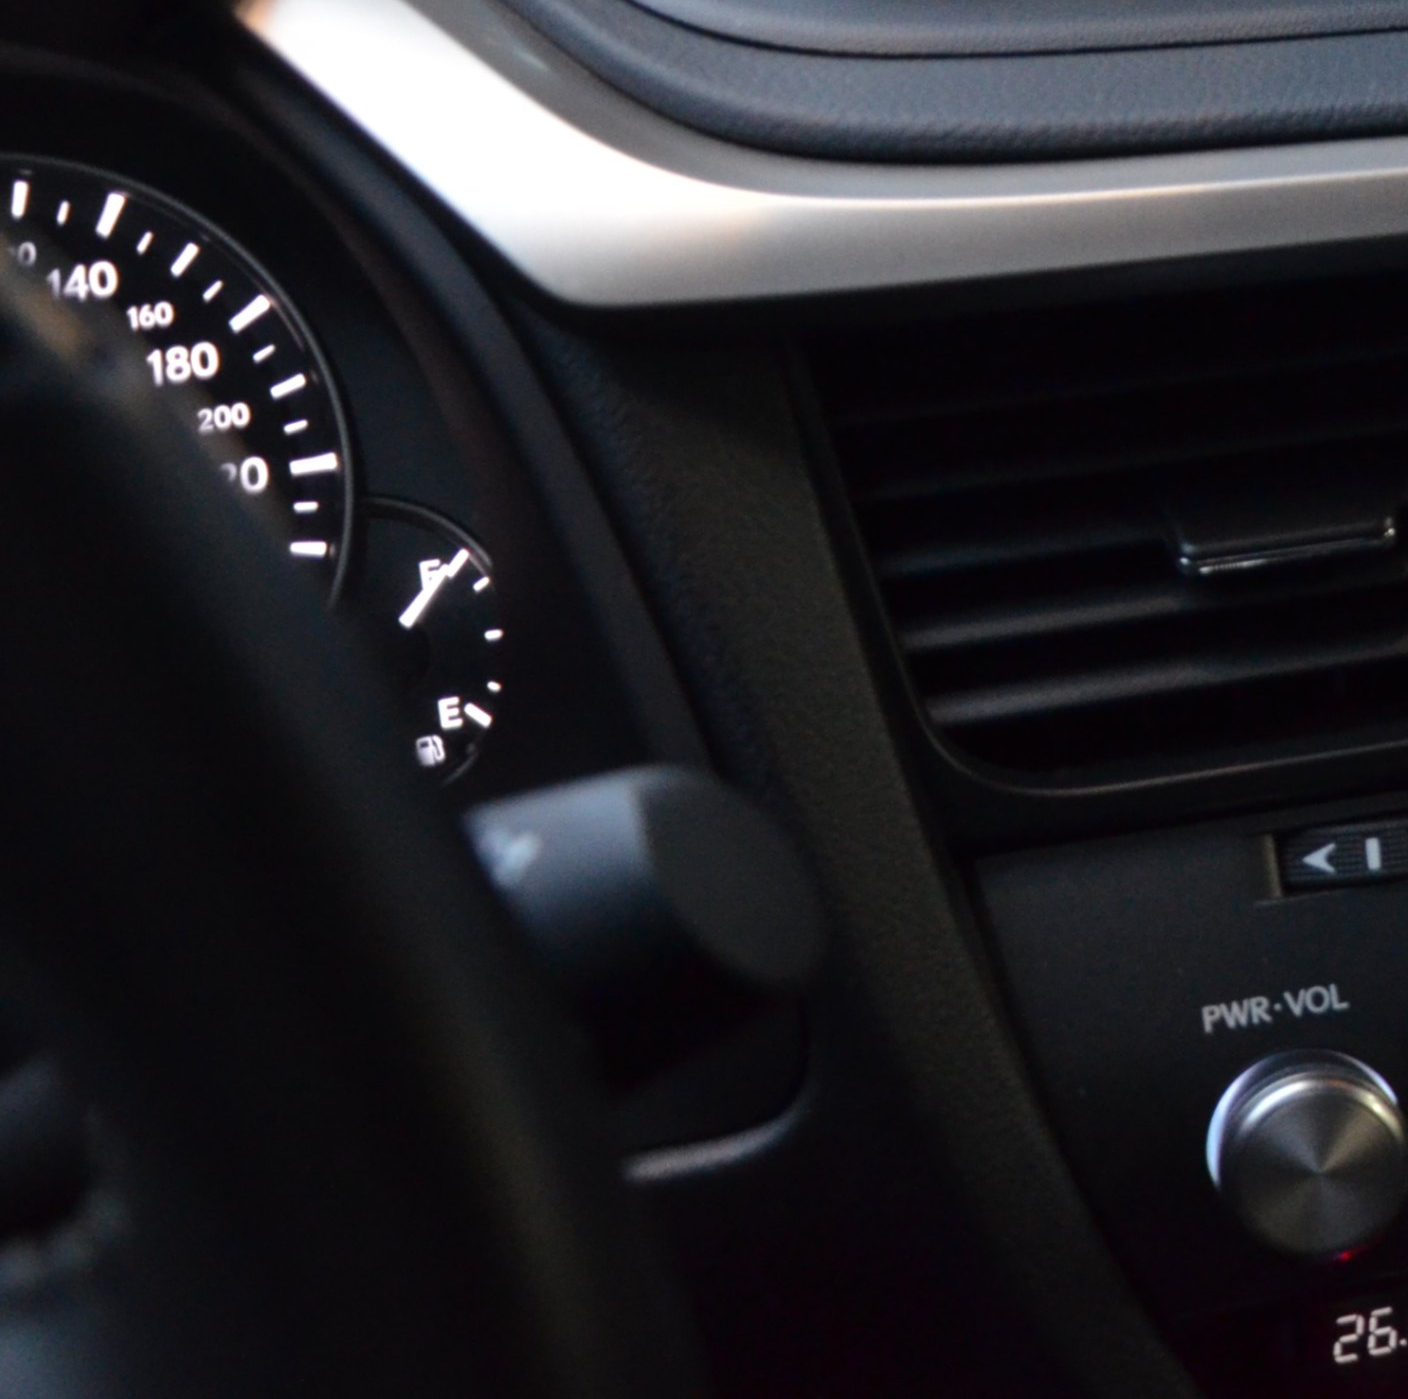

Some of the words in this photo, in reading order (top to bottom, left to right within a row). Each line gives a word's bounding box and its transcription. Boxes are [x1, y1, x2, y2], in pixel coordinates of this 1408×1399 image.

[47, 260, 119, 302] 140
[127, 301, 175, 331] 160
[146, 341, 220, 386] 180
[197, 402, 251, 433] 200
[438, 696, 463, 731] E
